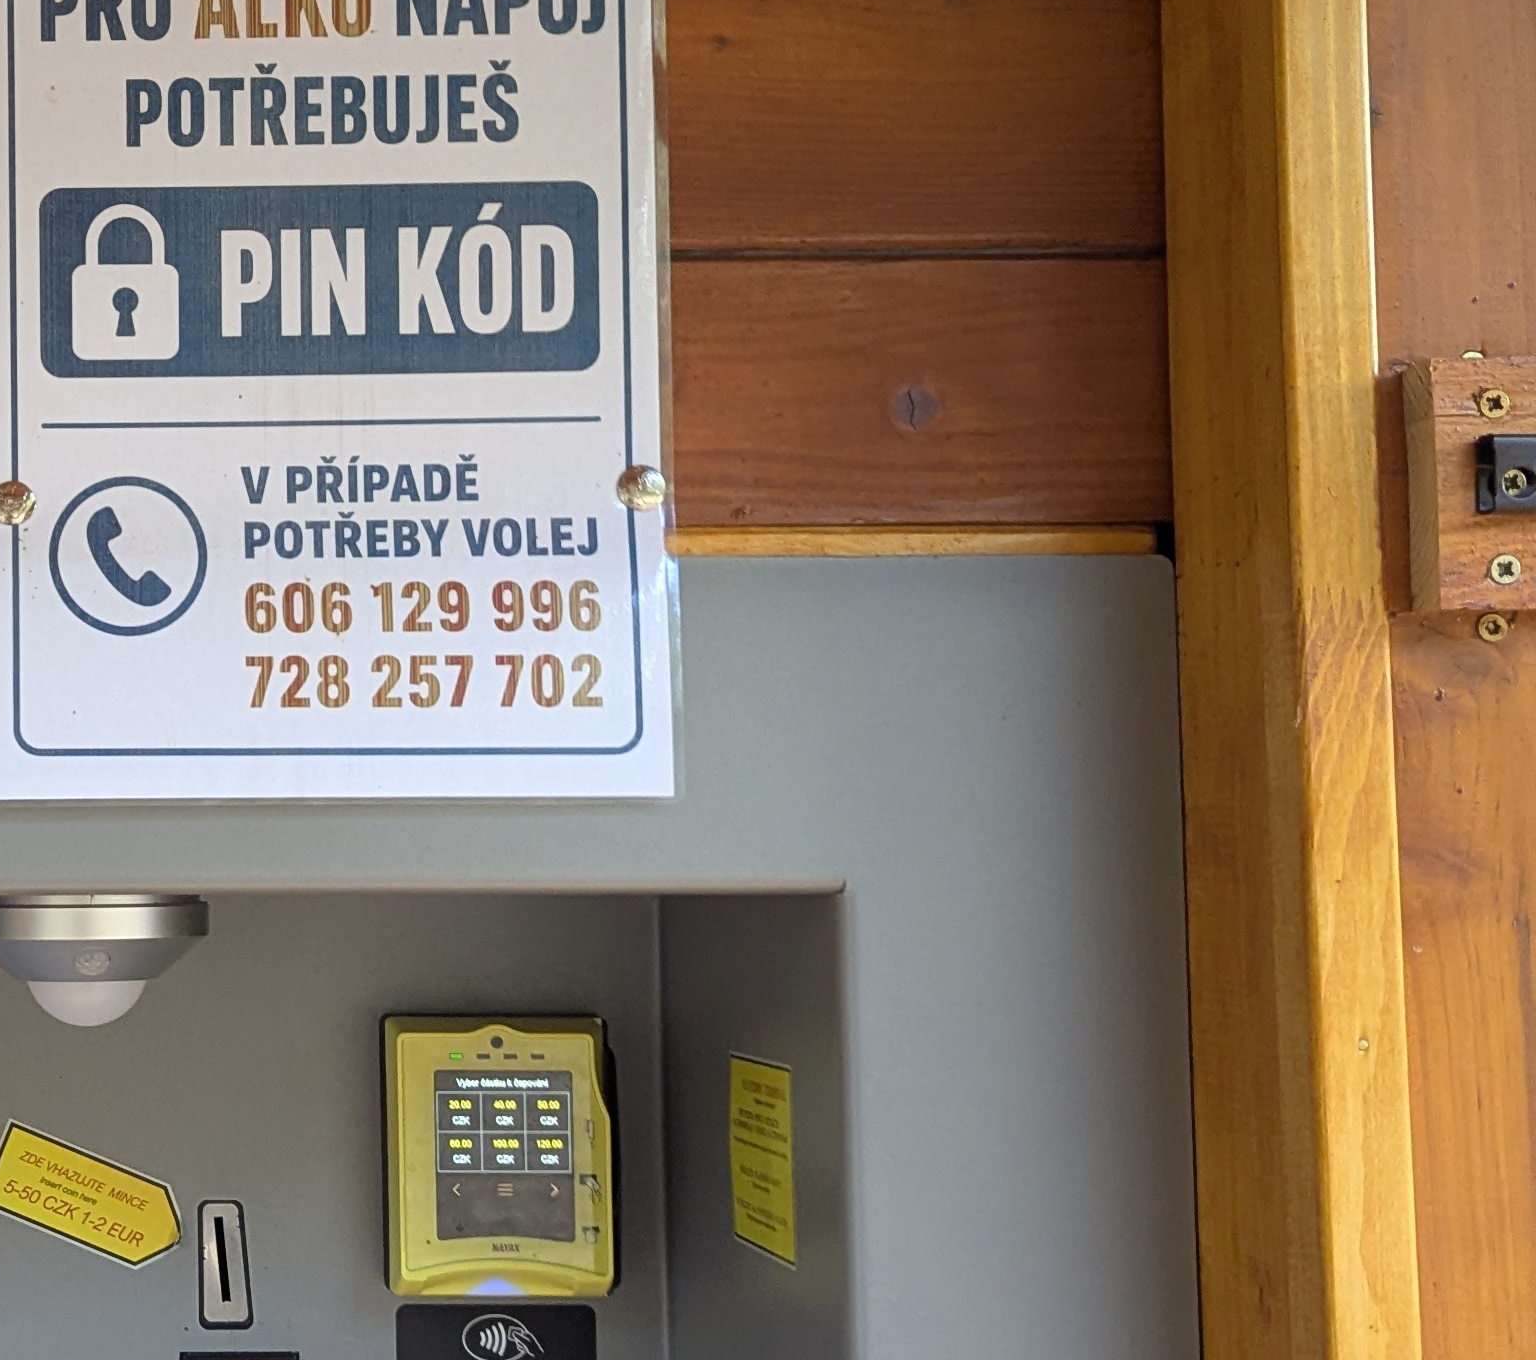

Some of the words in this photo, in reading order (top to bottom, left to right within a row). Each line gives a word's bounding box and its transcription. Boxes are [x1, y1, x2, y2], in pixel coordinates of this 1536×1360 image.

[126, 60, 519, 147] POTŘEBUJEŠ
[221, 228, 365, 337] PIN
[399, 203, 574, 334] KÓD
[241, 466, 270, 504] V
[287, 454, 478, 503] PŘÍPADĚ
[245, 512, 449, 559] POTŘEBY
[462, 518, 598, 556] VOLEJ
[245, 580, 352, 636] 606
[370, 581, 470, 632] 129
[492, 580, 601, 632] 996
[245, 655, 350, 708] 728
[371, 655, 473, 708] 257
[495, 654, 603, 708] 702
[19, 1150, 47, 1168] ZDE
[46, 1161, 106, 1194] VHAZUJTE
[108, 1187, 150, 1211] MINCE
[3, 1179, 42, 1205] 5-50
[42, 1195, 82, 1220] CZK
[81, 1211, 108, 1232] 1-2
[107, 1222, 146, 1247] EUR
